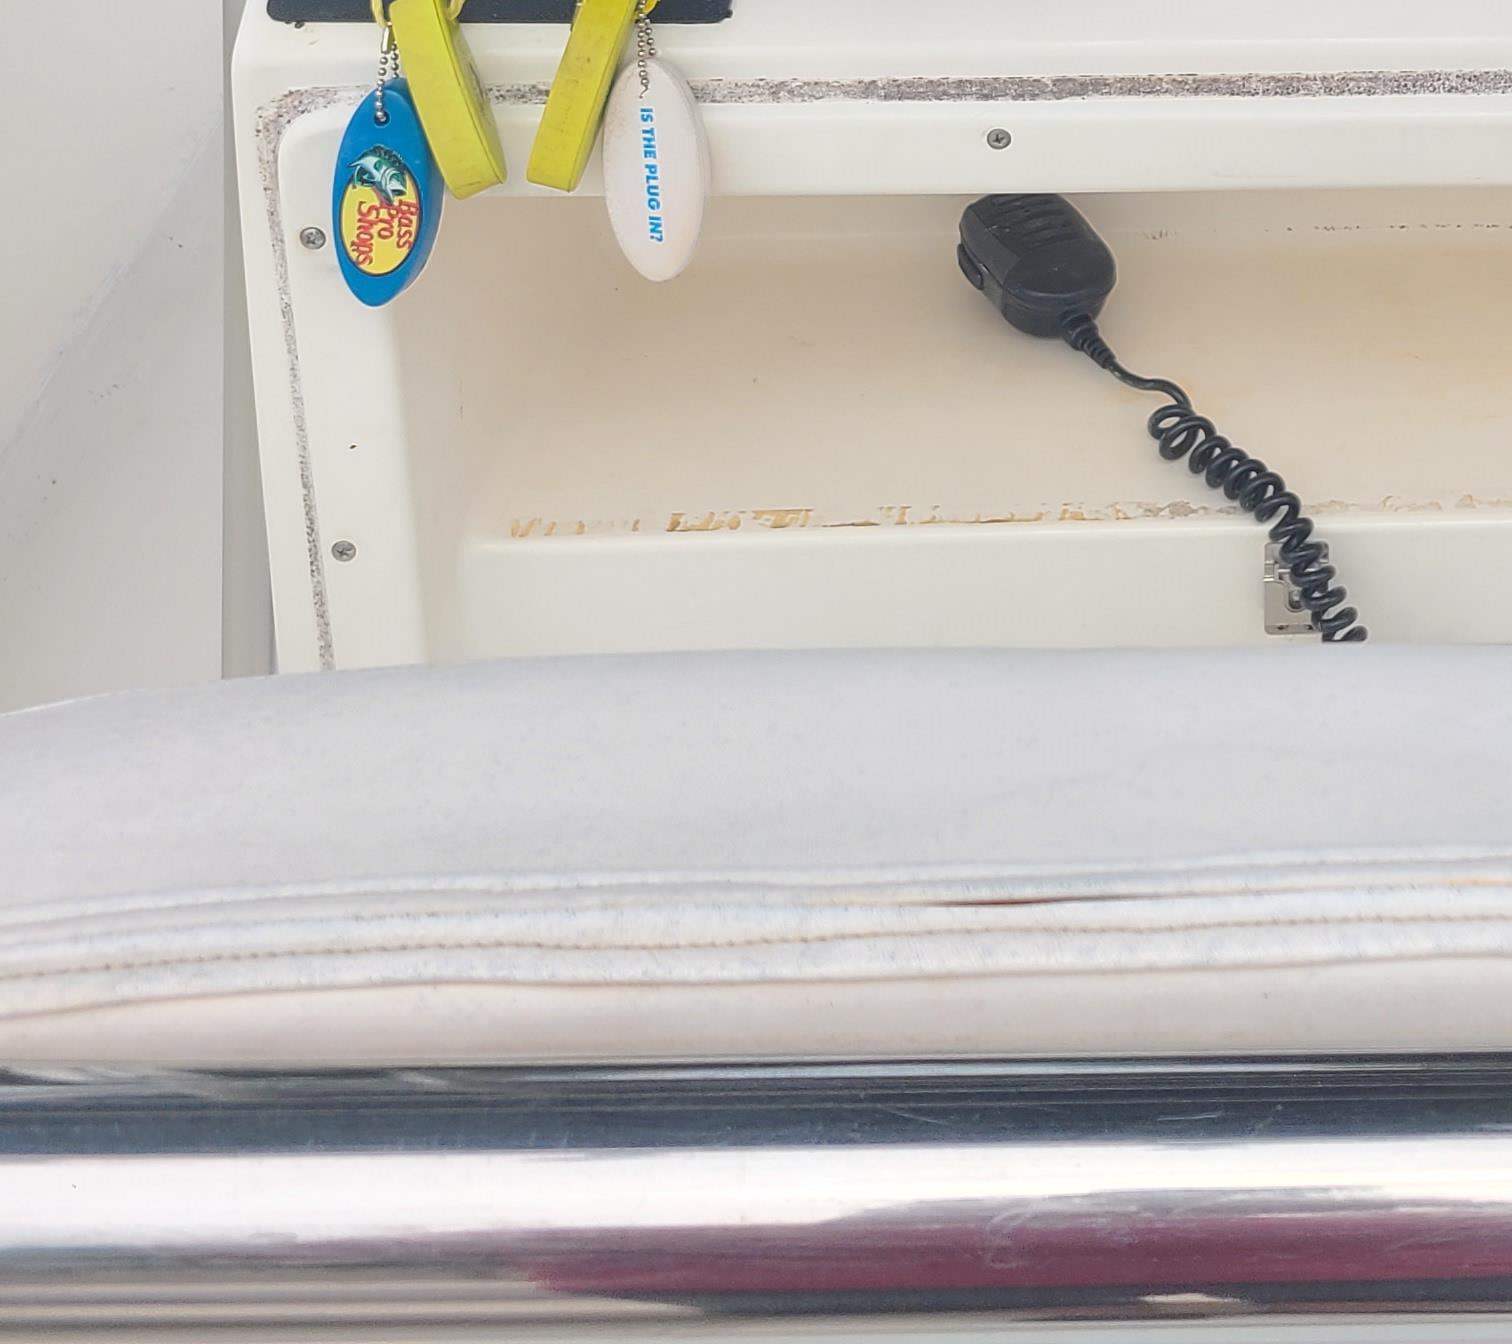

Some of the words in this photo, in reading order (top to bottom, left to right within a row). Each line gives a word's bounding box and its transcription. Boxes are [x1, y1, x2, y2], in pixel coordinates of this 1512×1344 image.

[640, 107, 654, 123] IS
[641, 127, 657, 159] THE
[644, 163, 661, 211] PLUG
[350, 200, 380, 266] Shops
[377, 202, 399, 240] Pro
[396, 199, 419, 250] Bass
[649, 215, 664, 243] IN?
